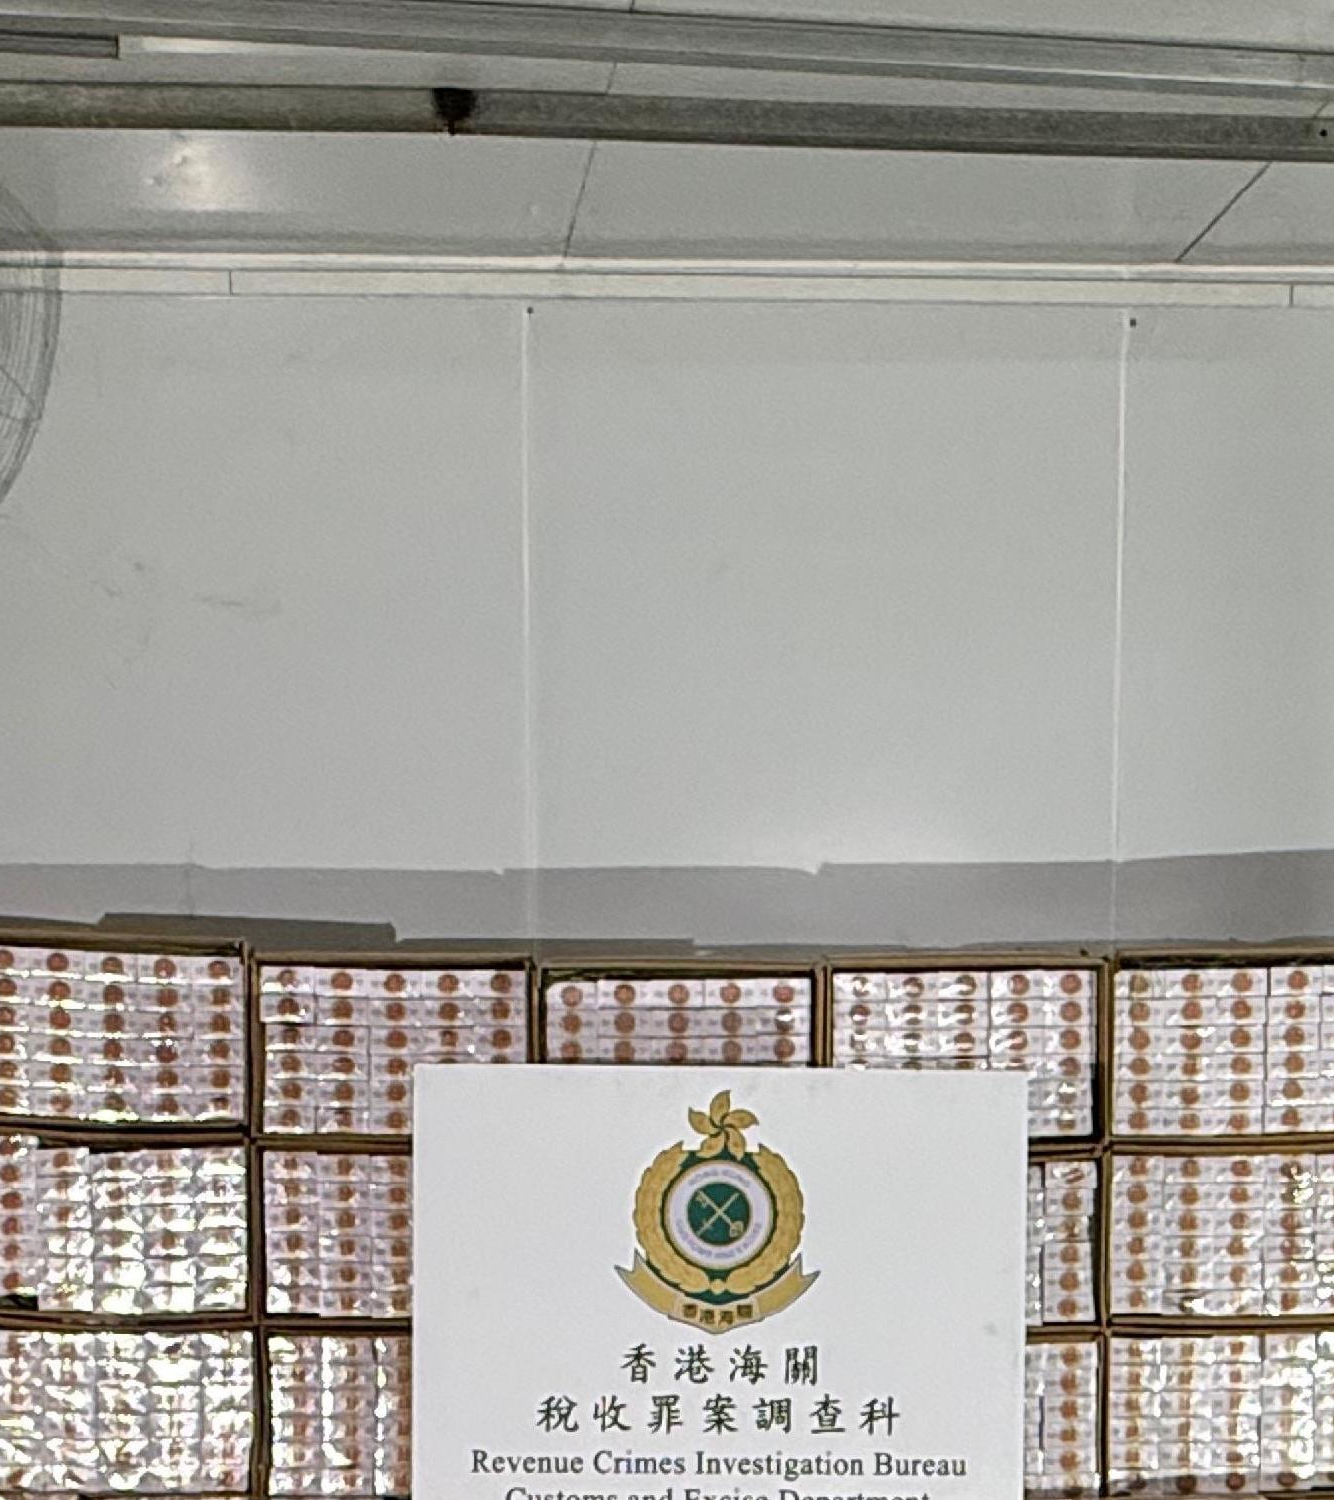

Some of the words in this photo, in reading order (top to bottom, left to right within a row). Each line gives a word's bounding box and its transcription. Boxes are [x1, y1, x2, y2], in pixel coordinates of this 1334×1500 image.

[620, 1343, 818, 1385] 香港海關
[537, 1393, 901, 1436] 稅收罪案調查科
[470, 1449, 584, 1474] Revenue
[593, 1449, 686, 1475] Crimes
[695, 1450, 865, 1481] Investigation
[873, 1451, 967, 1476] Bureau
